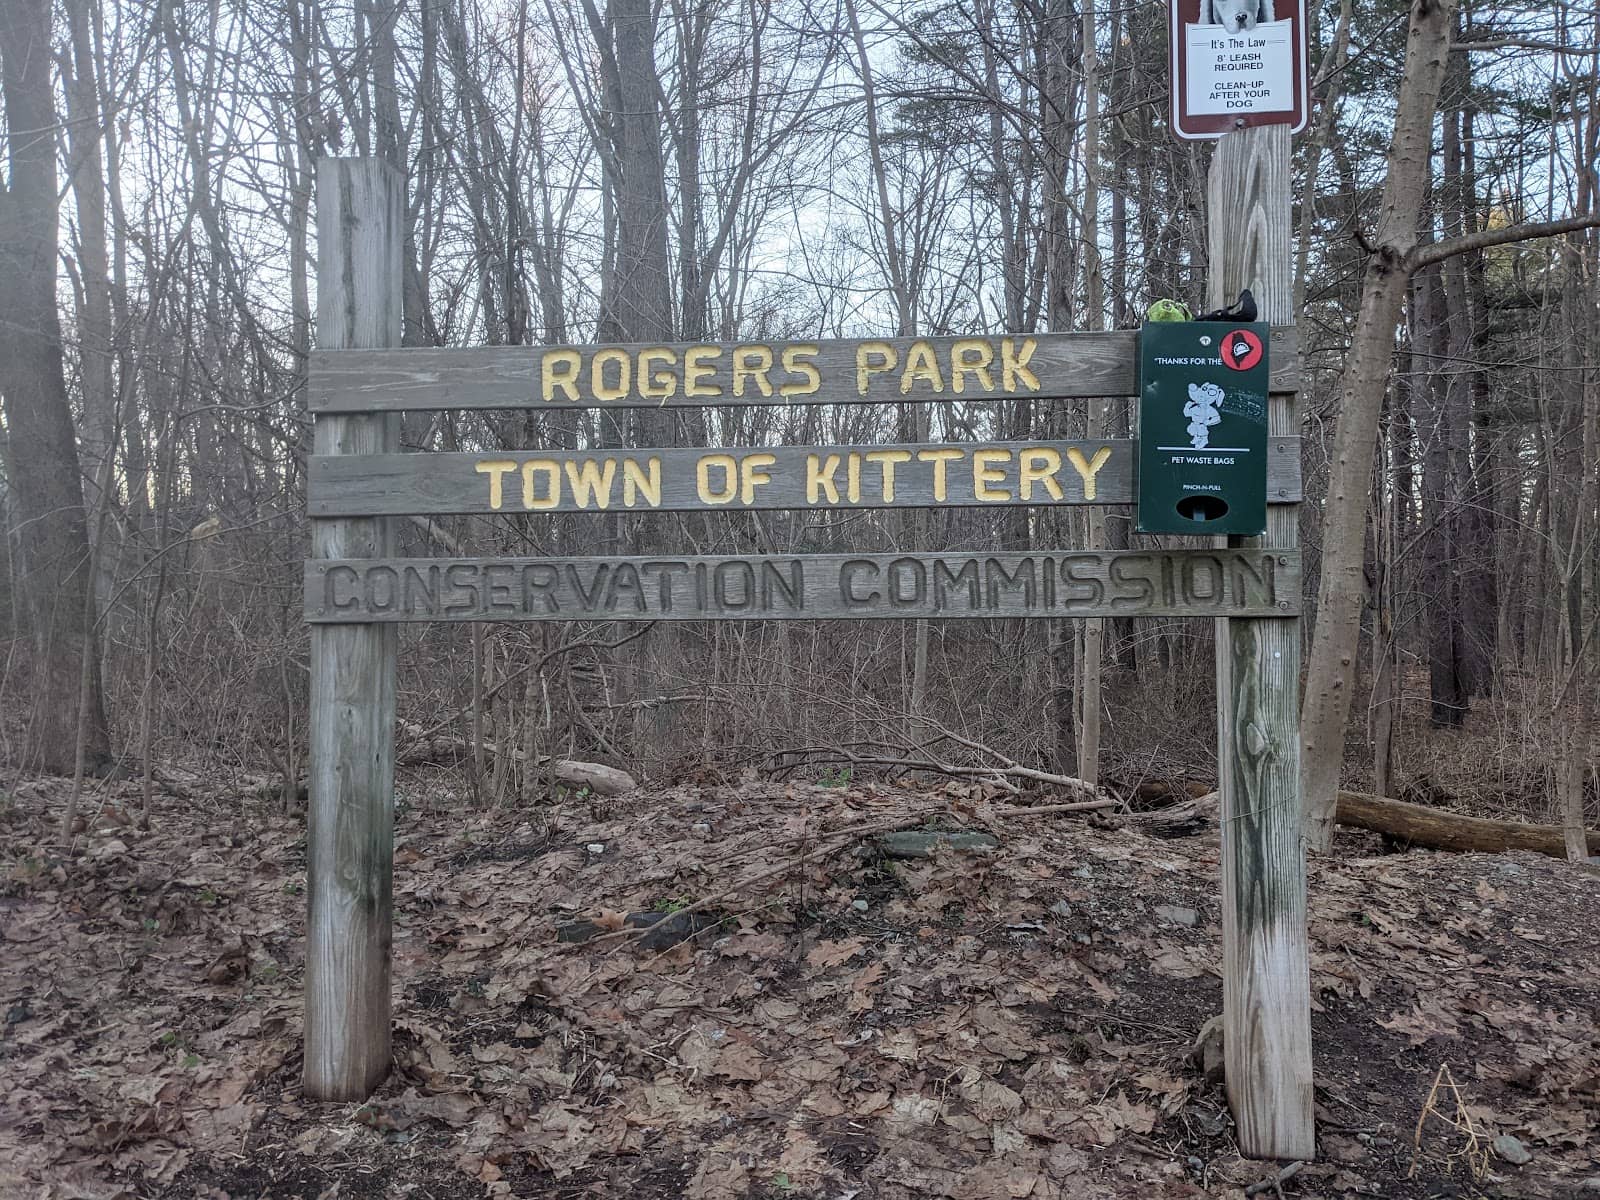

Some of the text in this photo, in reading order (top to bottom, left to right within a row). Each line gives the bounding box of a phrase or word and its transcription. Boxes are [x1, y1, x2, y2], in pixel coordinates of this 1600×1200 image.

[1211, 38, 1266, 49] It's The Law
[1230, 53, 1261, 61] LEASH
[1214, 62, 1264, 71] REQUIRED
[1214, 80, 1264, 90] CLEAN-UP
[1209, 90, 1271, 100] AFTER YOUR
[1226, 100, 1253, 108] DOG
[1190, 357, 1206, 366] FOR
[1208, 358, 1223, 366] THE
[540, 337, 1041, 401] ROGERS PARK
[1171, 456, 1235, 465] PET WASTE BAGS
[475, 446, 1112, 510] TOWN OF KITTERY
[324, 554, 1275, 615] CONSERVATION COMMISSION
